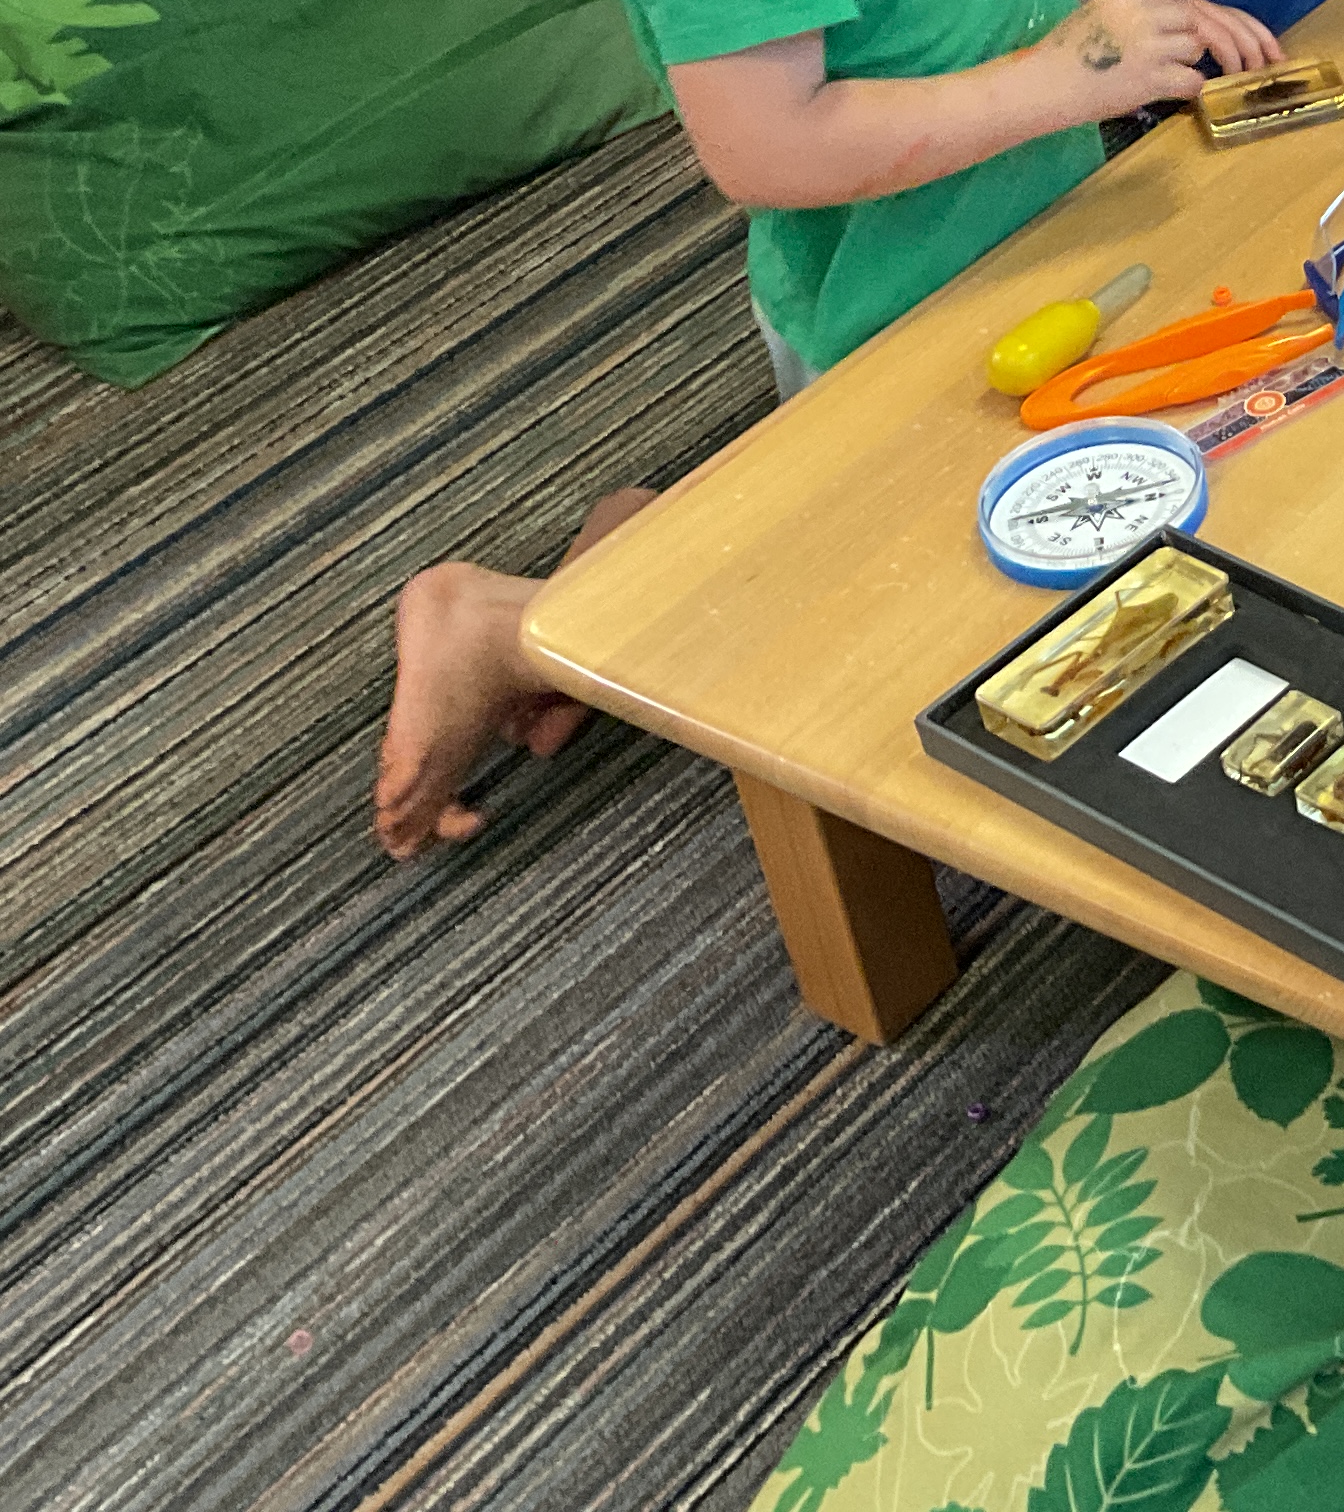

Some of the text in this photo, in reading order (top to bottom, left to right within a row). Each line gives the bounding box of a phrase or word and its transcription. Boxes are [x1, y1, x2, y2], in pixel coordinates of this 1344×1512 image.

[1086, 470, 1102, 481] W
[1120, 472, 1148, 485] NW
[1046, 482, 1073, 502] SW
[1035, 515, 1049, 524] S
[1126, 514, 1149, 532] NE
[1047, 532, 1073, 547] SE
